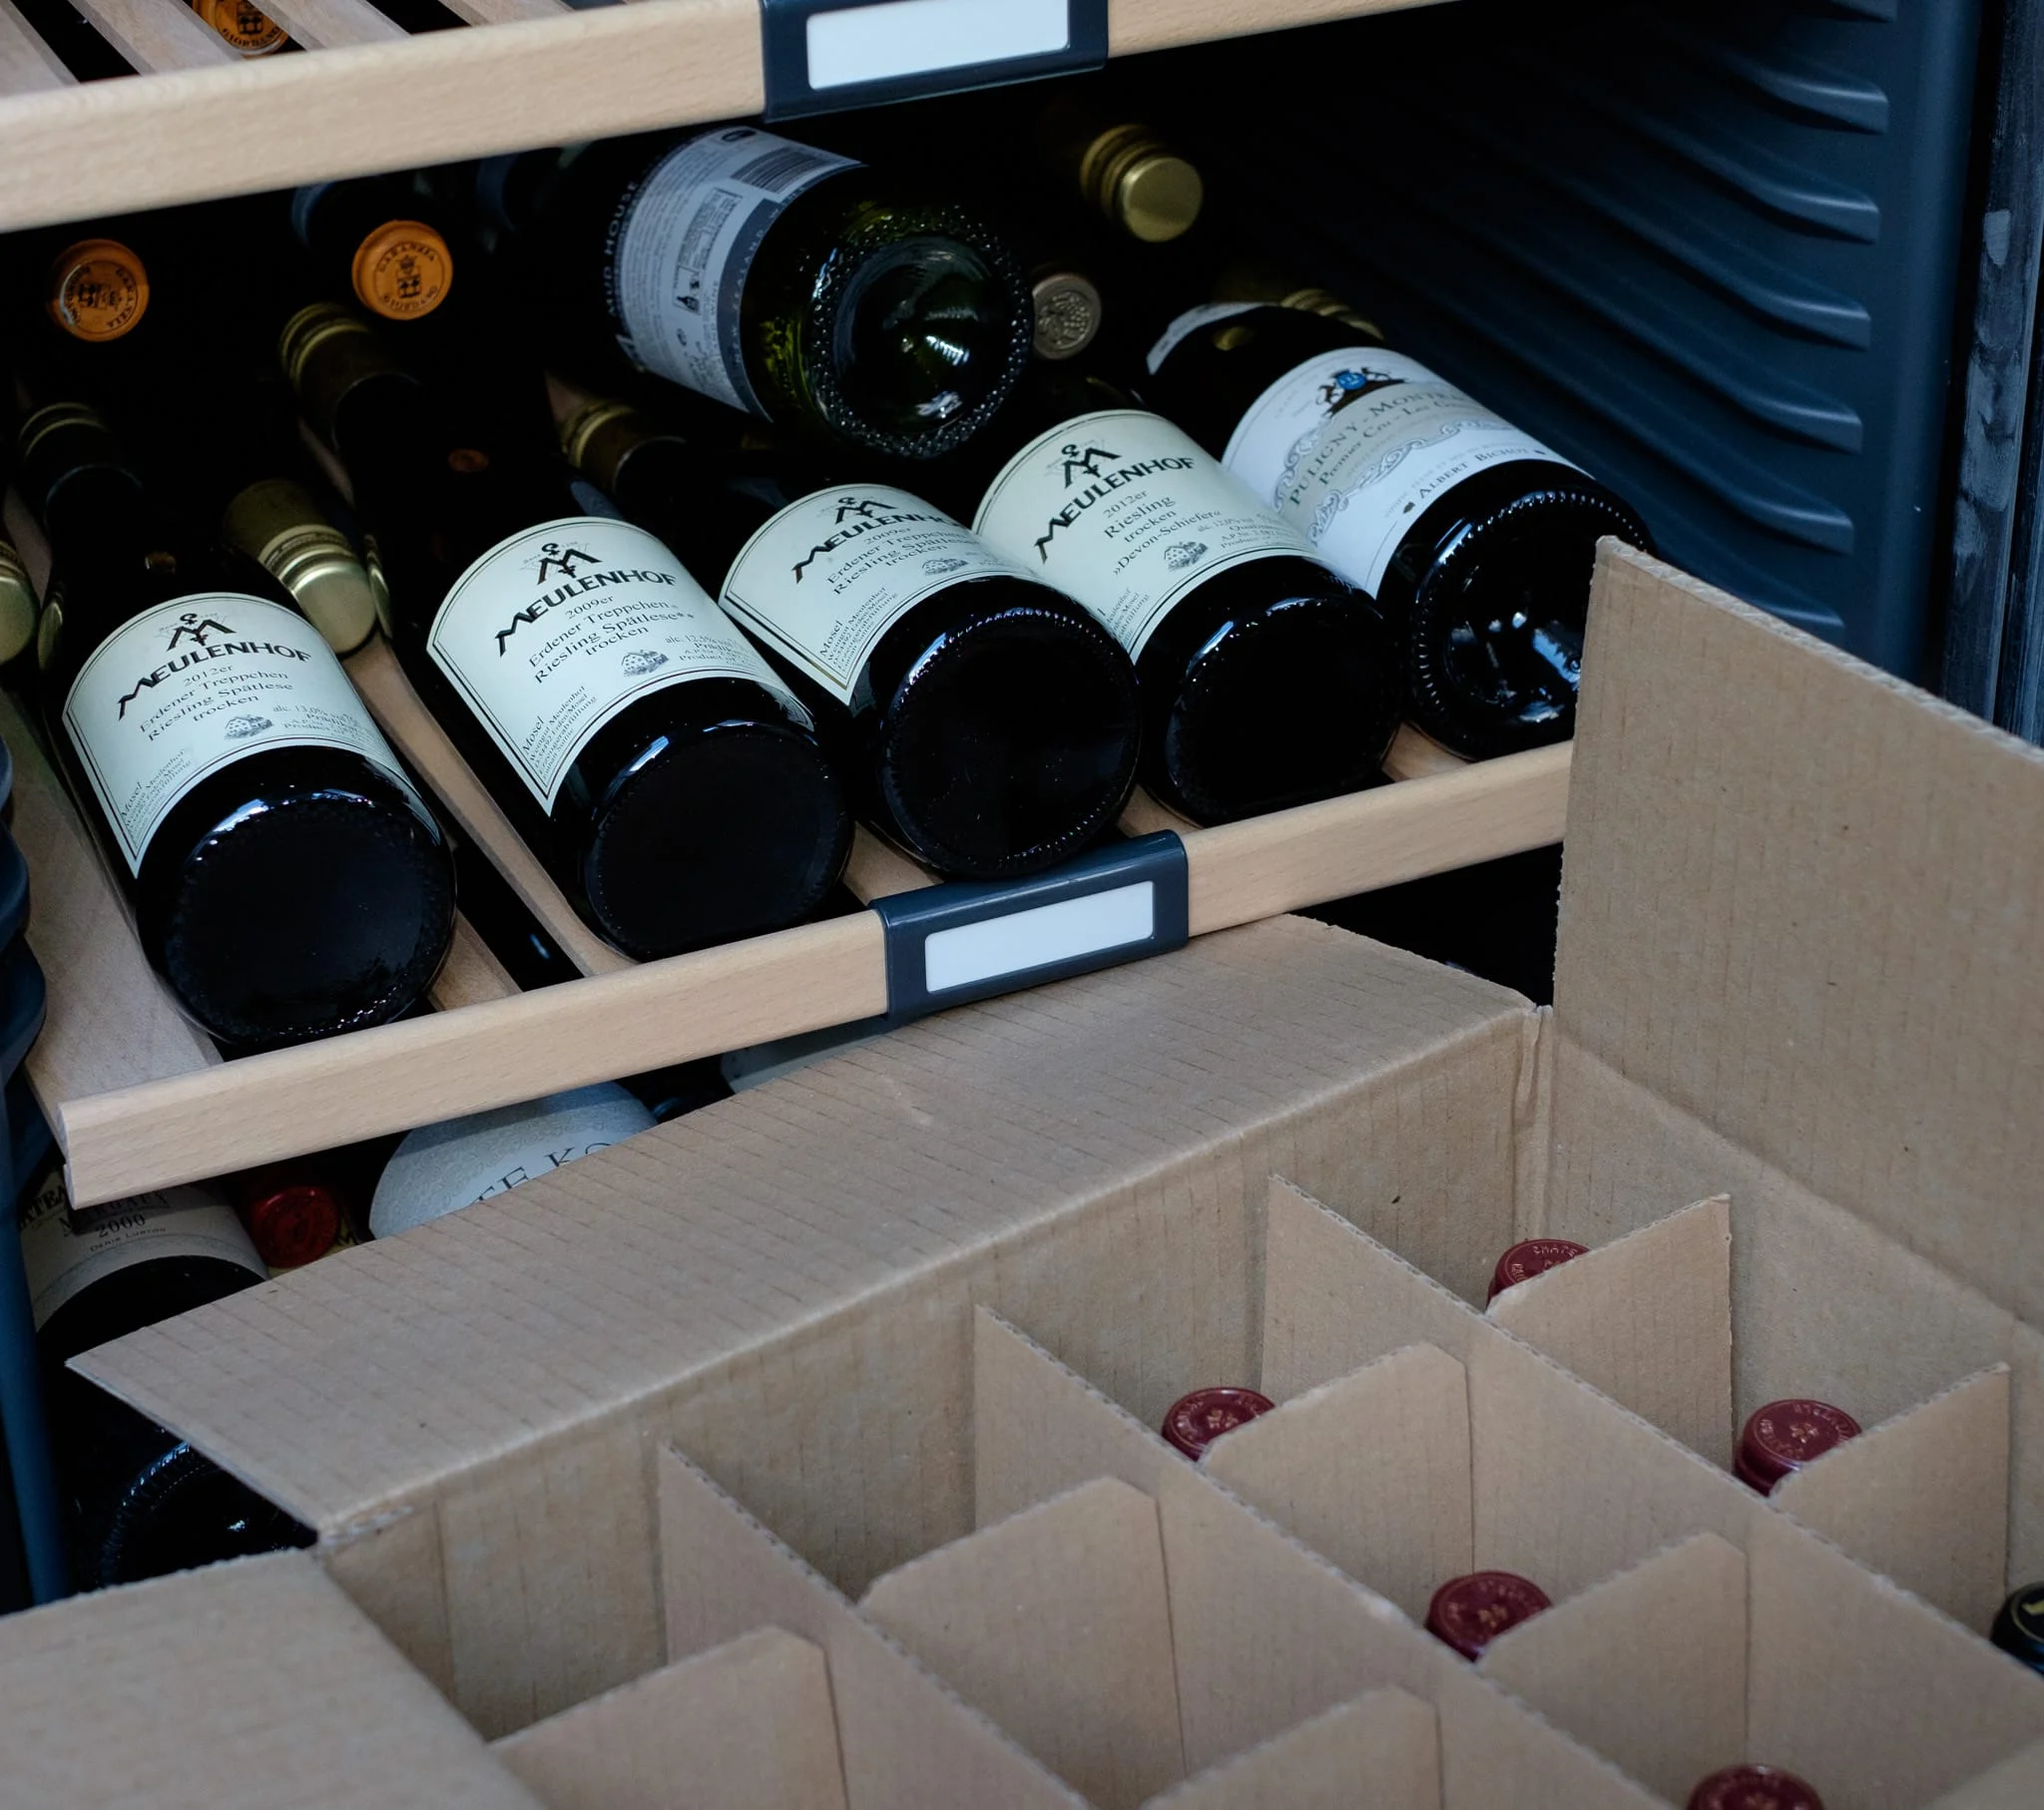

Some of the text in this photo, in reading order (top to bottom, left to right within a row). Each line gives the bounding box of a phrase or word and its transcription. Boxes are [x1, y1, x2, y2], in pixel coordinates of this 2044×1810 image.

[1288, 421, 1359, 506] PULIGNY
[1419, 461, 1469, 499] ALBERT
[1033, 457, 1196, 566] MEULENHOF
[1102, 489, 1149, 519] 2012er
[1104, 496, 1177, 539] Riesling
[1124, 509, 1178, 544] trocken
[826, 545, 881, 585] Erdener
[832, 550, 902, 597] Riesling
[884, 544, 949, 568] trocken
[494, 569, 678, 658] MEULENHOF
[565, 595, 614, 620] 2009er
[528, 600, 671, 669] Erdener Treppchen
[585, 625, 651, 657] trocken
[819, 619, 843, 659] Mosel
[183, 664, 235, 688] 2012er
[534, 631, 599, 684] Riesling
[117, 641, 312, 721] MEULENHOF
[139, 670, 289, 733] Erdener Treppchen
[147, 682, 295, 742] Riesling Spätlese
[193, 693, 260, 722] trocken
[522, 714, 545, 755] Mosel
[94, 1212, 147, 1239] 2000
